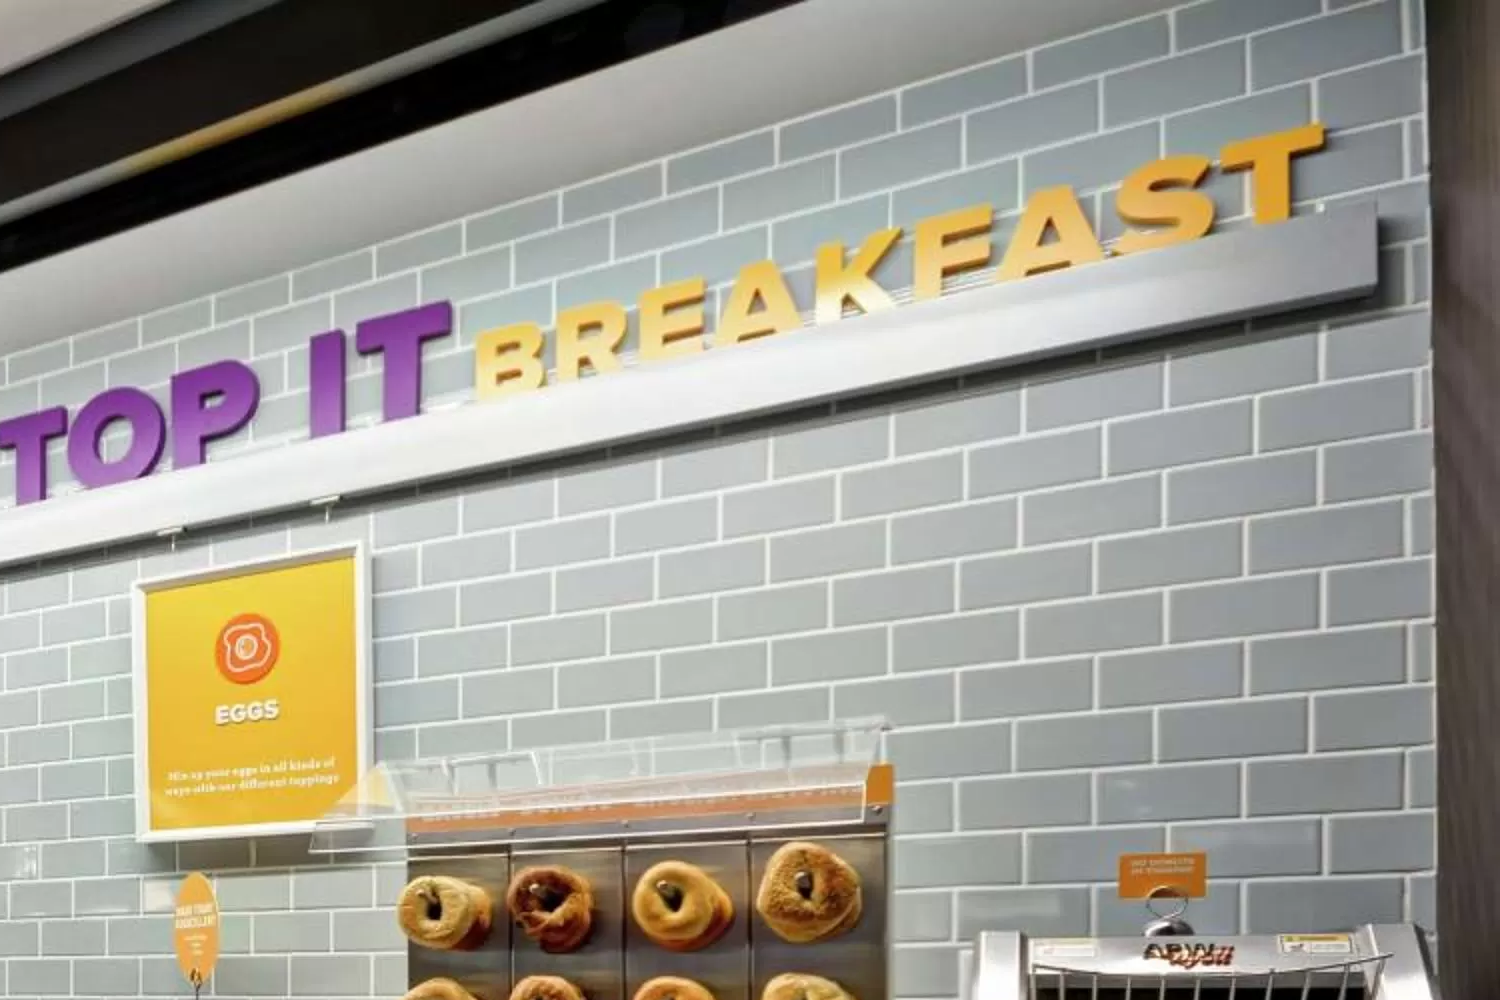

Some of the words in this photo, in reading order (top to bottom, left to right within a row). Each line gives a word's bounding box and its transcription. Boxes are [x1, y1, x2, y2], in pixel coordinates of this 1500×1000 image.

[309, 299, 454, 441] IT
[472, 121, 1327, 401] BREAKFAST
[213, 698, 281, 727] EGGS
